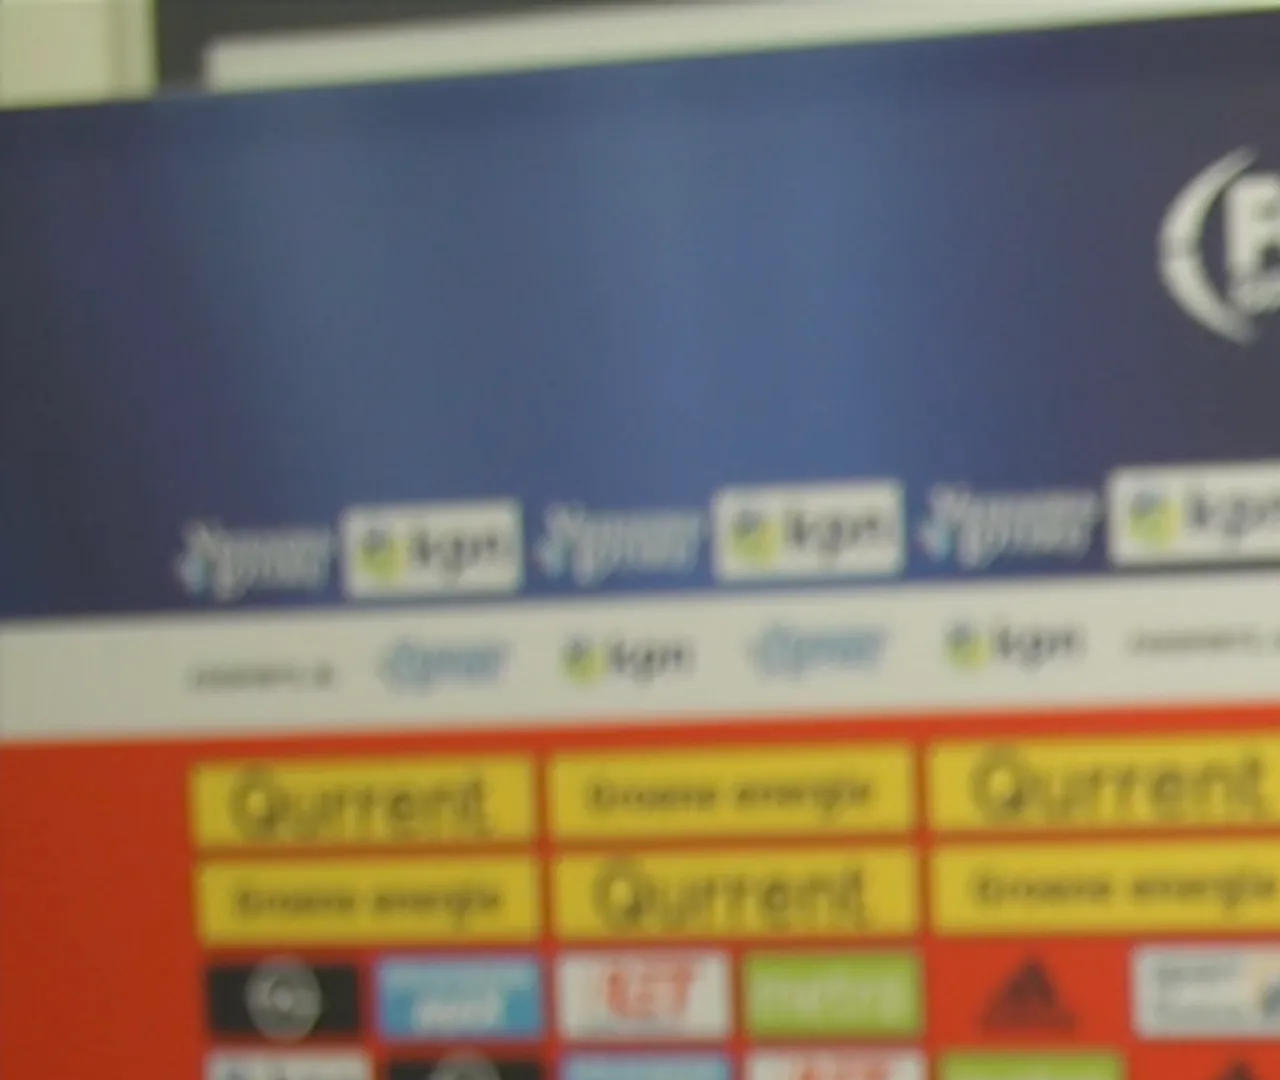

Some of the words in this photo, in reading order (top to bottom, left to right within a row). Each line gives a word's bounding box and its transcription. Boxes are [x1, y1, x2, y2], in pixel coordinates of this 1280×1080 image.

[970, 744, 1267, 824] Qurrent
[971, 873, 1115, 907] Groene
[1127, 871, 1279, 915] energie
